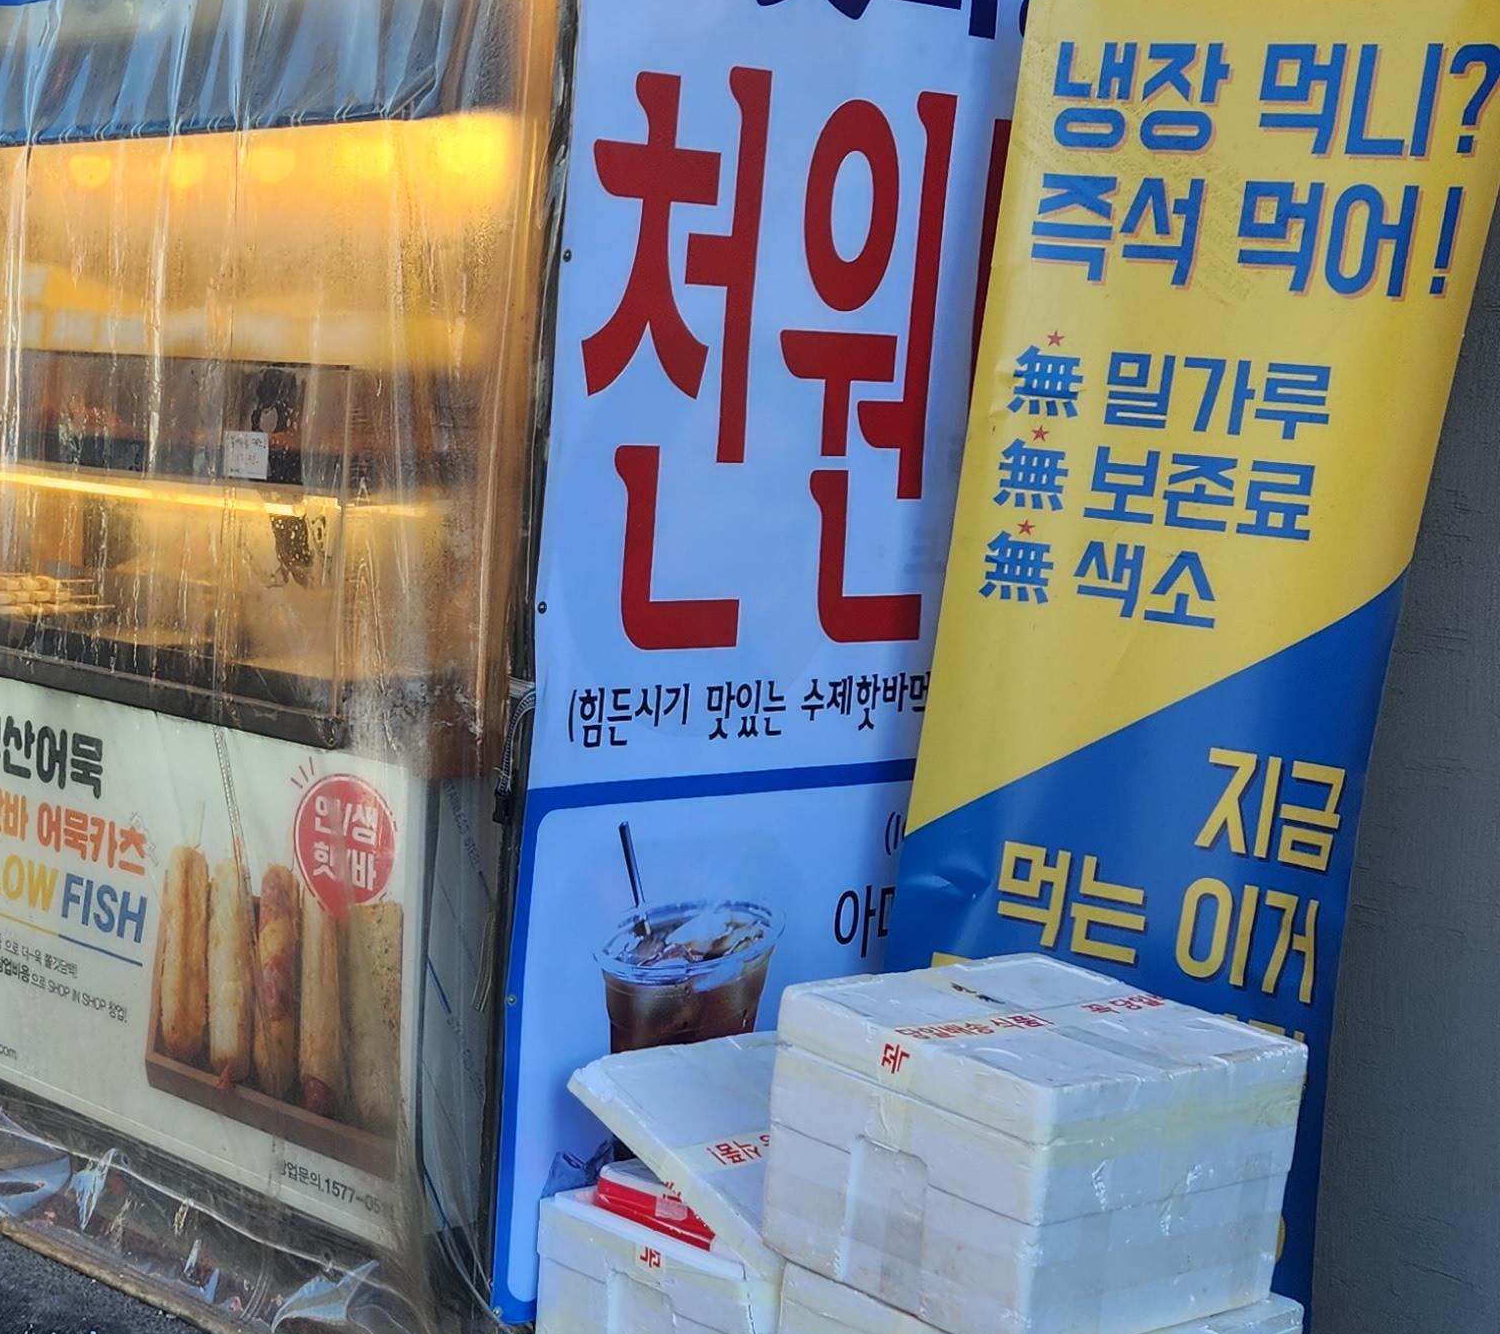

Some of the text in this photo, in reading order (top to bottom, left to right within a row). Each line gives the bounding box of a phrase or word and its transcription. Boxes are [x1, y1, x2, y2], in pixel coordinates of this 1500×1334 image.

[1052, 41, 1500, 158] 냉장 먹니?
[1031, 172, 1464, 300] 즉석 먹어!
[580, 65, 1012, 651] 천원
[1006, 345, 1332, 440] 無 밀가루
[992, 438, 1315, 541] 無 보존료
[979, 530, 1217, 629] 無 색소
[567, 682, 691, 748] (힘든시기
[706, 679, 787, 741] 맛있는
[37, 802, 147, 876] 어묵카츠
[315, 795, 377, 849] 인생
[1194, 747, 1346, 871] 지금
[61, 872, 148, 944] FISH
[313, 841, 377, 892] 핫바
[4, 938, 20, 956] 으로
[997, 840, 1320, 1004] 먹는 이거
[47, 980, 70, 998] SHOP
[82, 993, 106, 1011] SHOP
